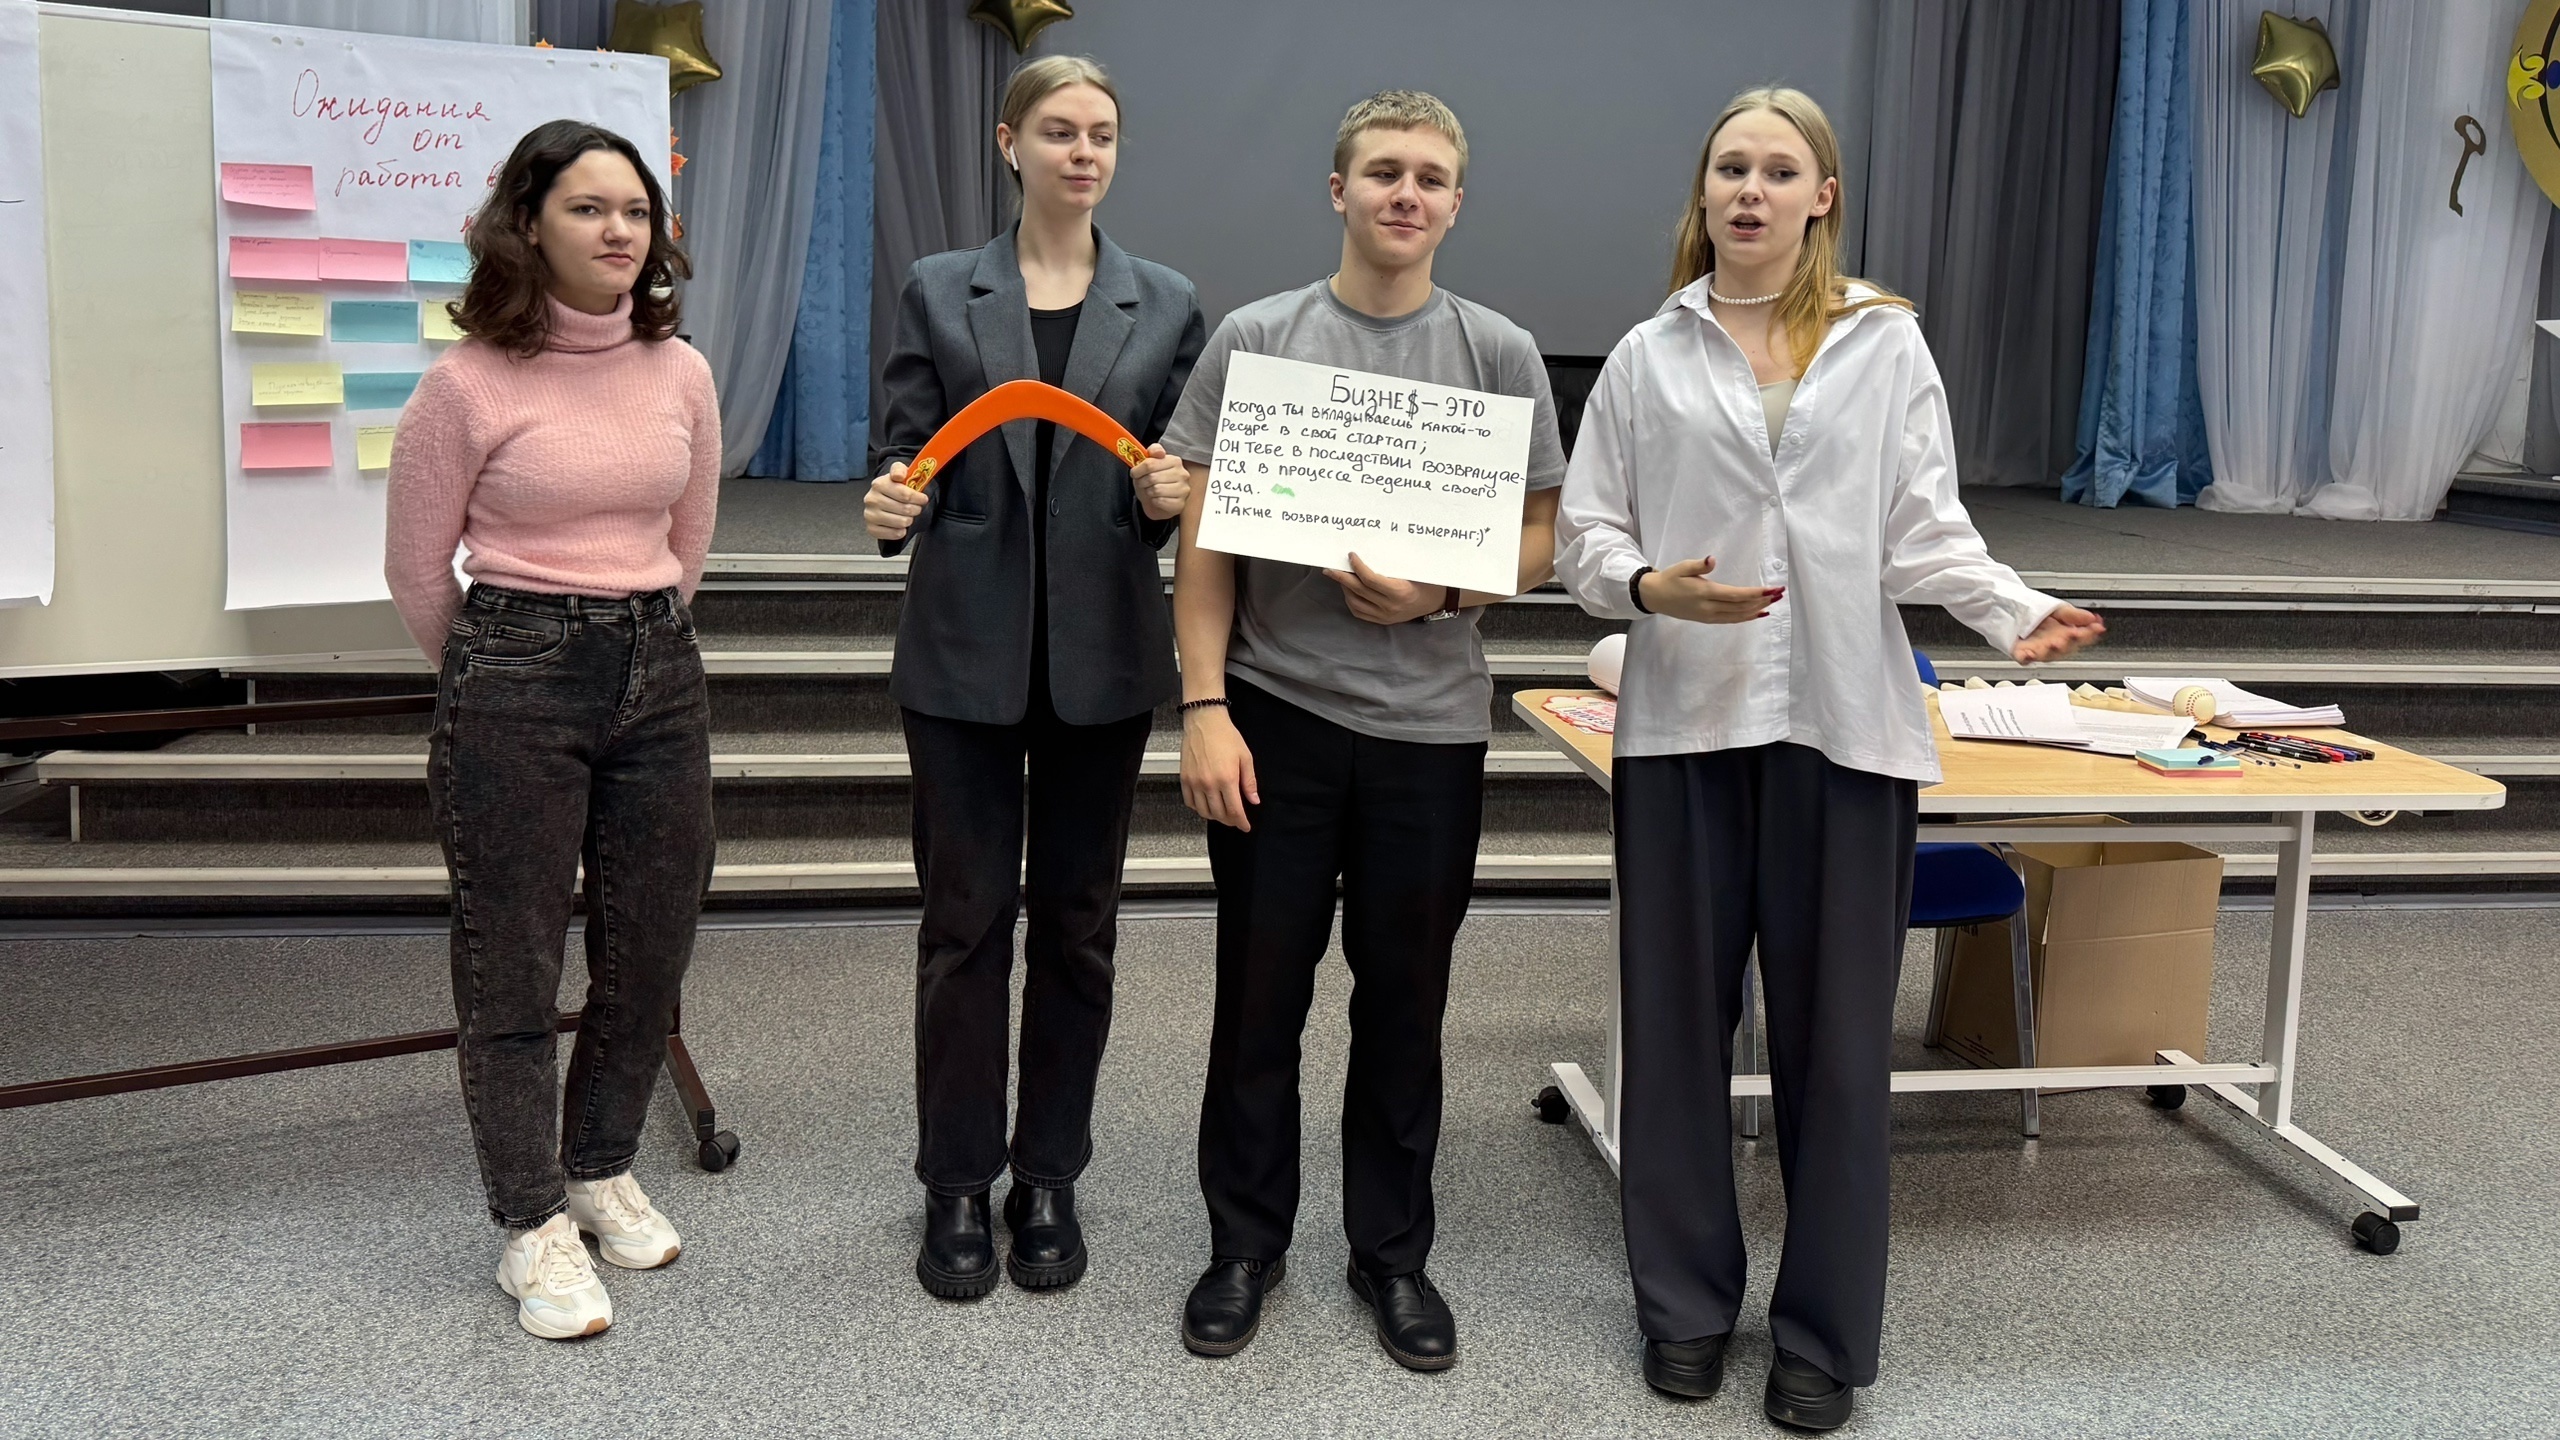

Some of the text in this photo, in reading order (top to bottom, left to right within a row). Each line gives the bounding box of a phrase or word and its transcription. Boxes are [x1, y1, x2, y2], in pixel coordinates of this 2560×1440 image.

[292, 68, 493, 145] Ожидания
[413, 129, 464, 152] от
[335, 159, 462, 198] работы
